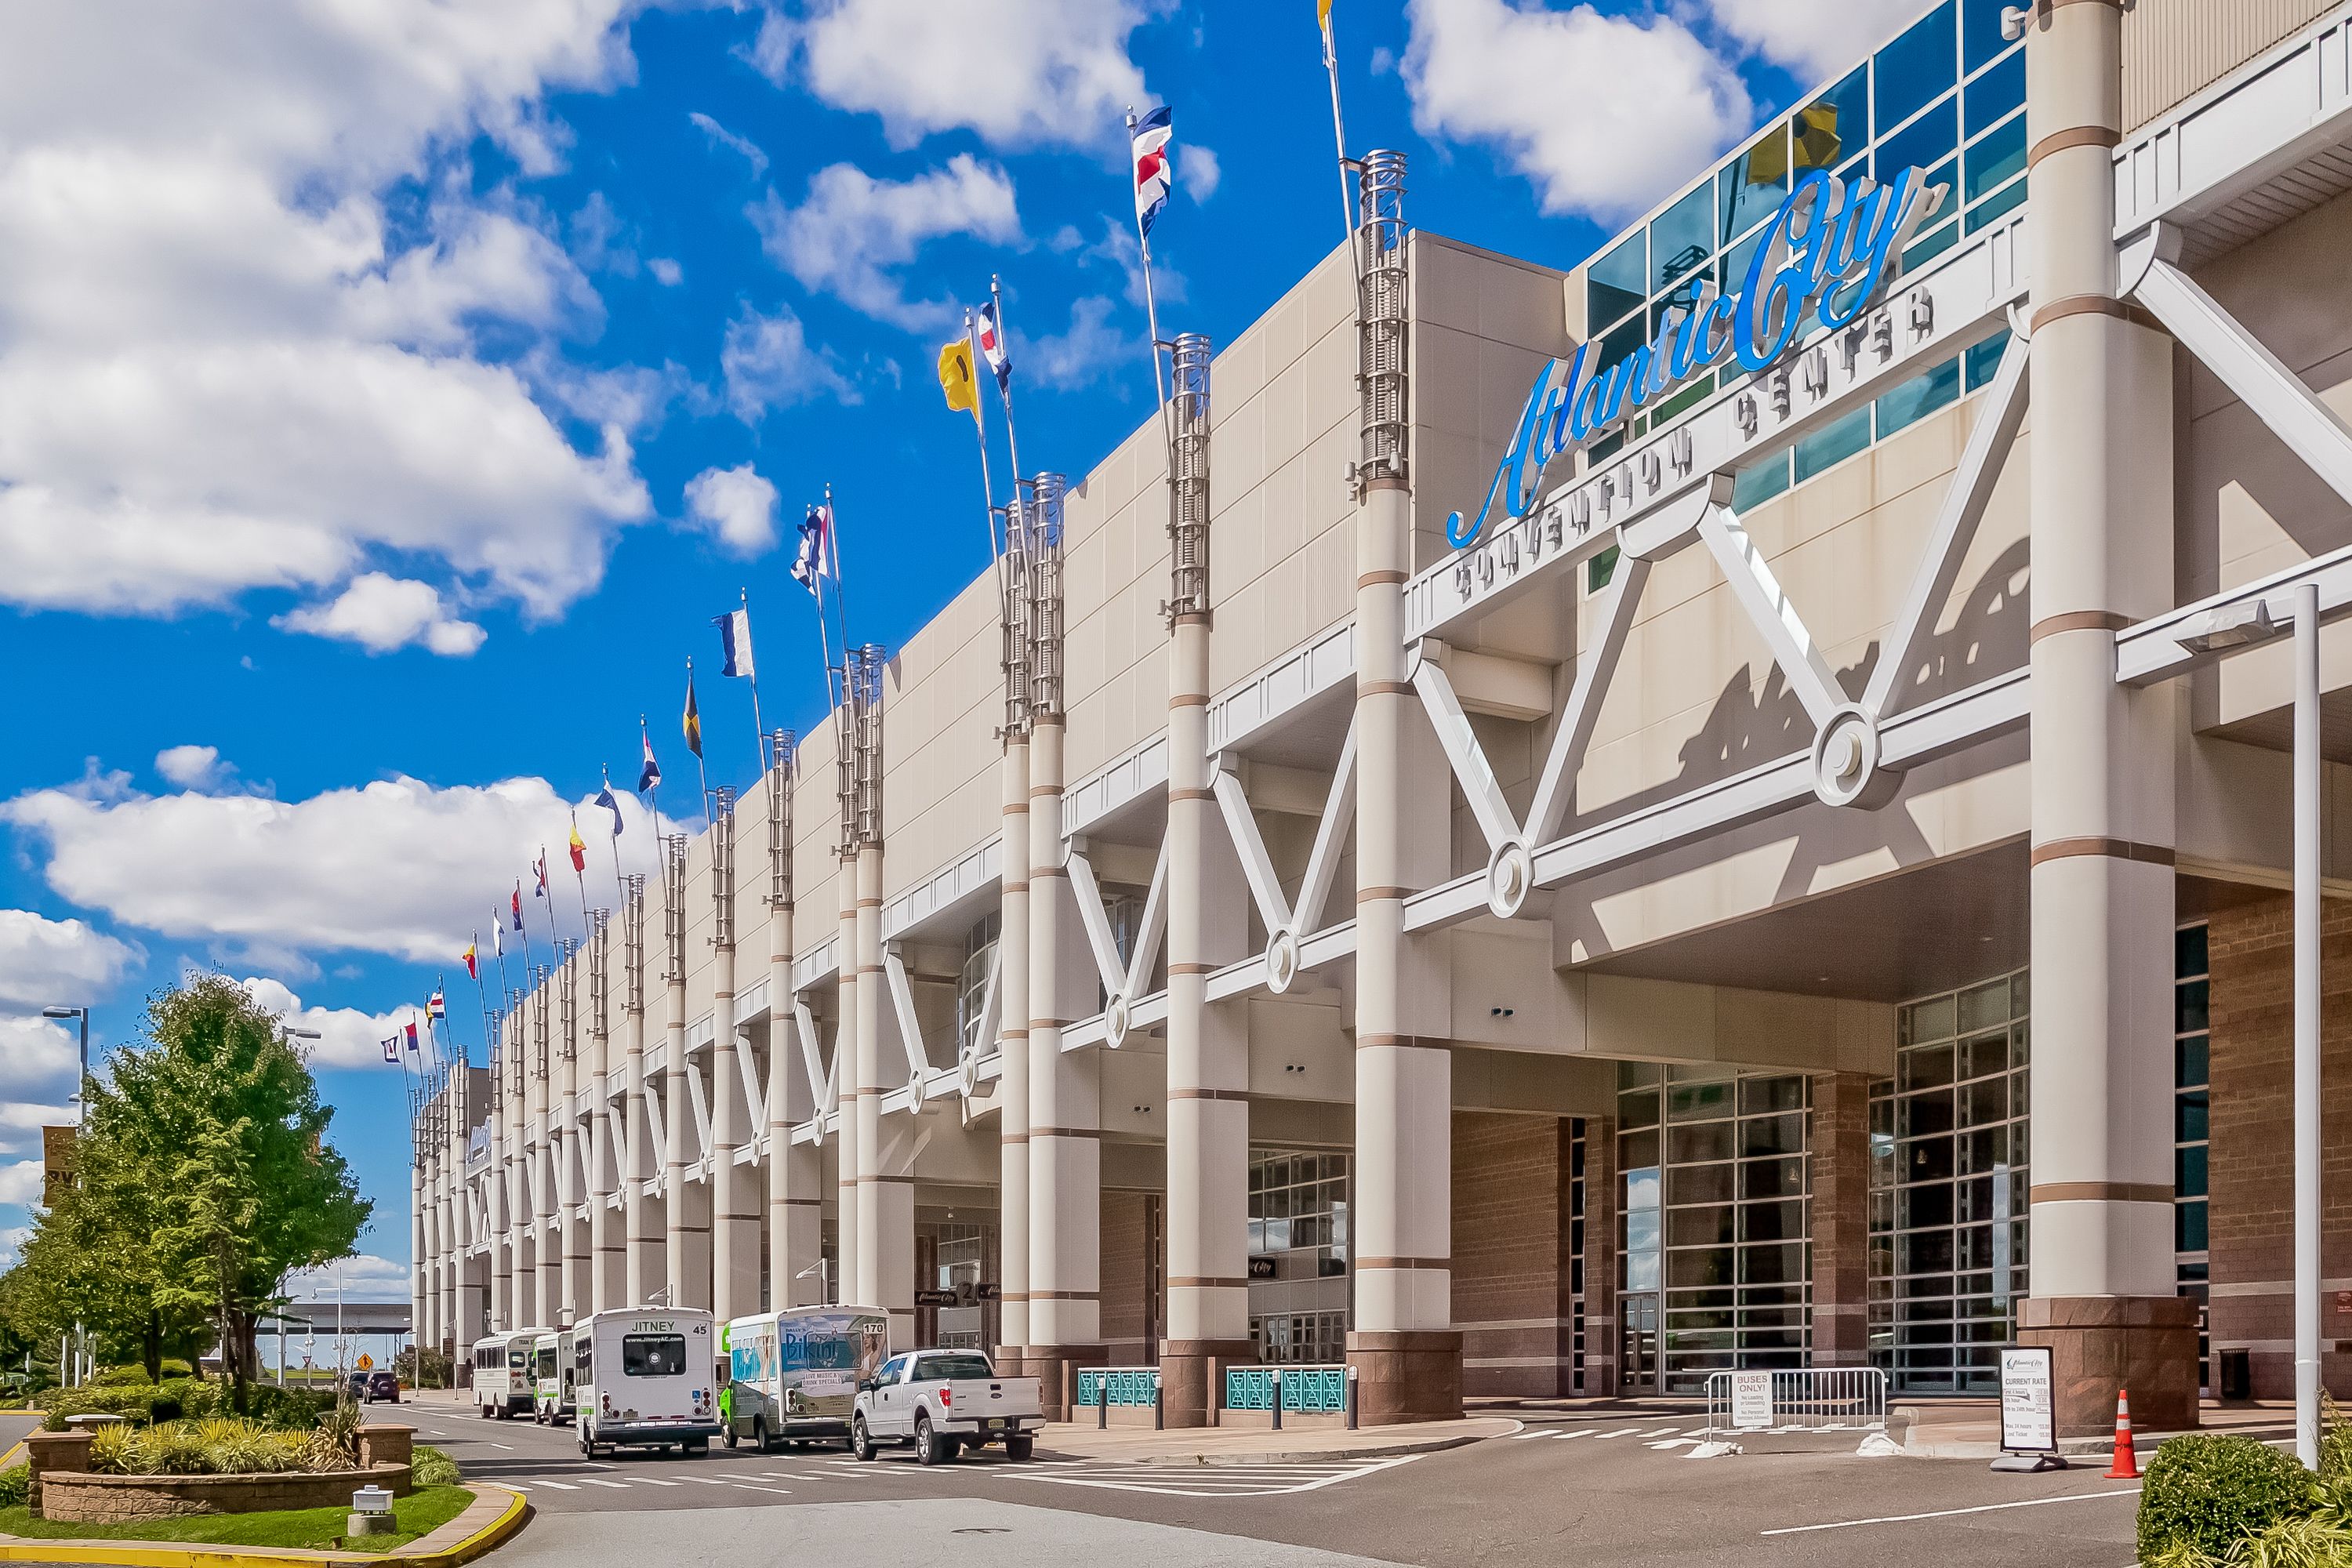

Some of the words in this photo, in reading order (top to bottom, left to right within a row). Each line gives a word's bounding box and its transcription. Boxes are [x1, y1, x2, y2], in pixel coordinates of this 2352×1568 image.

[1446, 279, 1738, 550] Atlantic
[1735, 166, 1949, 372] City
[1454, 428, 1693, 600] CONVENTION
[1733, 285, 1934, 433] CENTER
[920, 1293, 940, 1301] Atlantic
[962, 1283, 972, 1298] 2
[632, 1321, 675, 1332] JITNEY
[692, 1326, 707, 1334] 45
[864, 1324, 884, 1333] 170
[786, 1334, 837, 1359] Bikini
